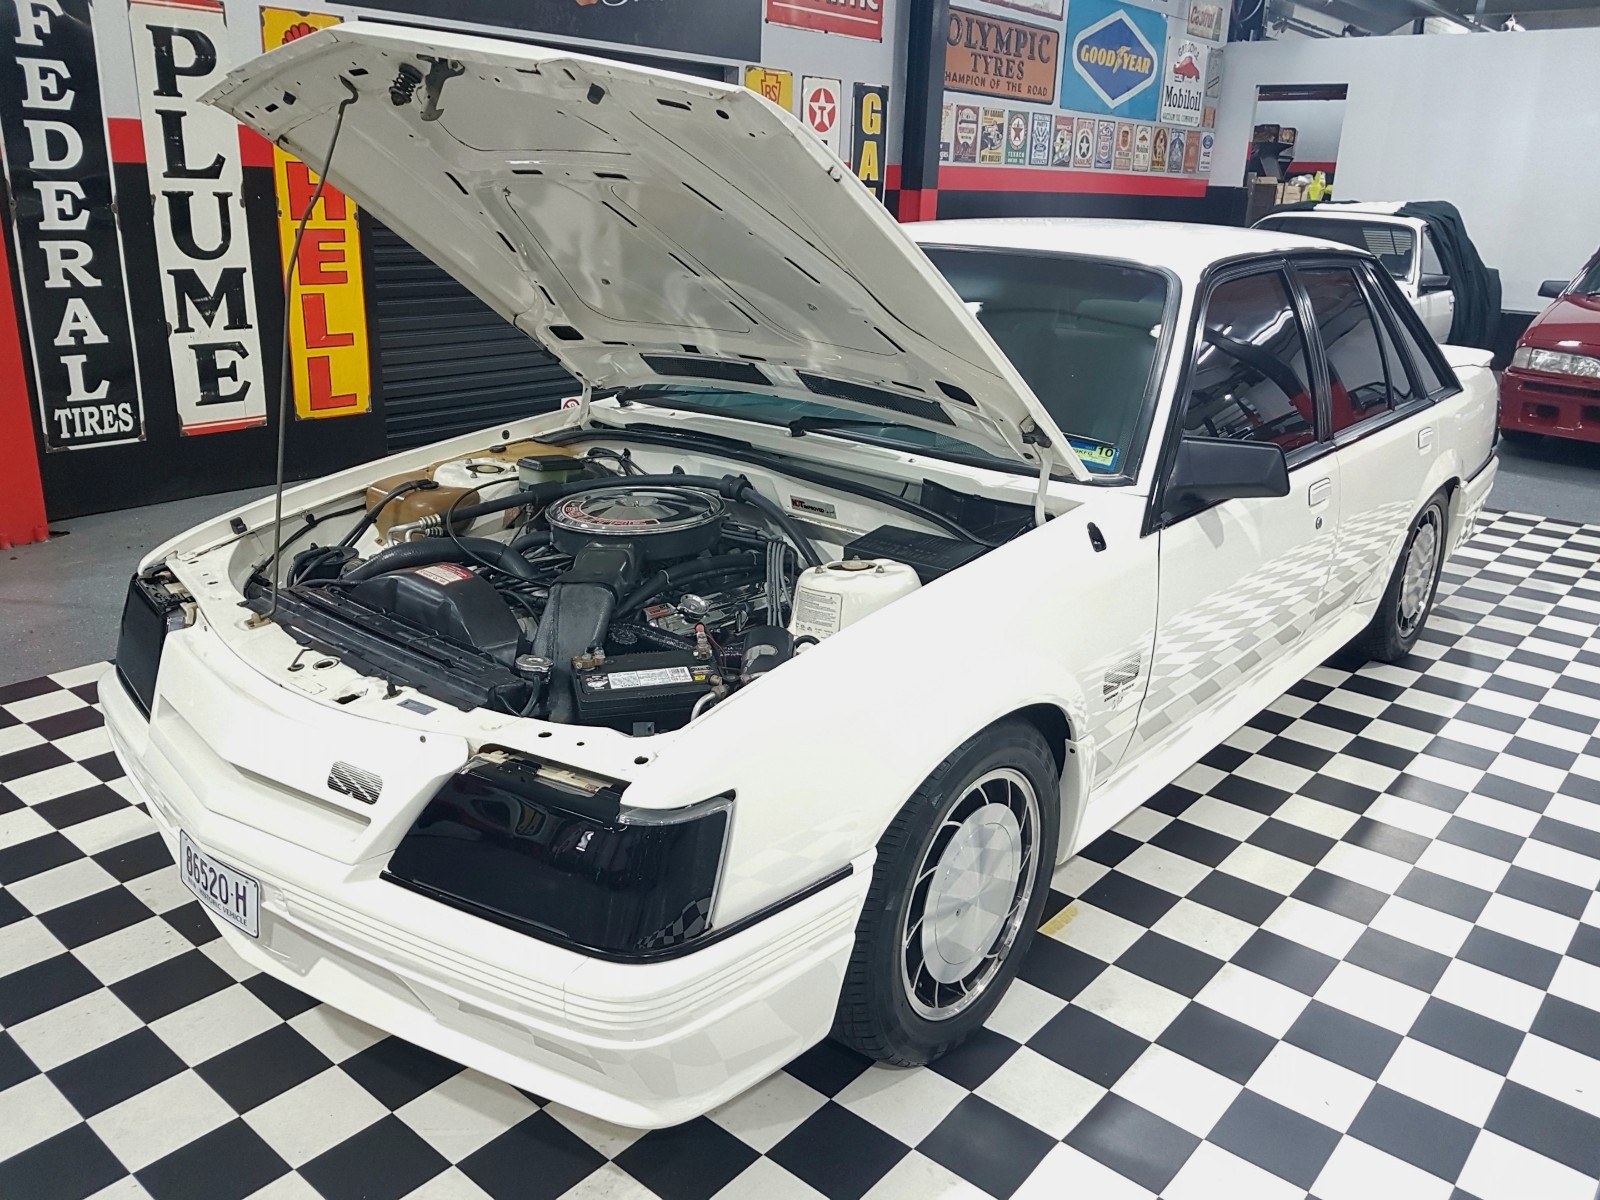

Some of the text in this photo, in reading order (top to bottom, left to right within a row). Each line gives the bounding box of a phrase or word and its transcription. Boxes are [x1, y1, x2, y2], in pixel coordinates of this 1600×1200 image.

[947, 13, 1051, 64] OLYMPIC
[970, 52, 1025, 81] TYRES
[944, 71, 1048, 97] HAMPION OF THE ROAD
[1164, 85, 1202, 111] Mobiloil
[14, 0, 110, 402] FEDERAL
[146, 24, 253, 407] PLUME
[54, 402, 134, 440] TIRES
[1098, 446, 1114, 458] 10
[222, 906, 248, 927] VEHICLE
